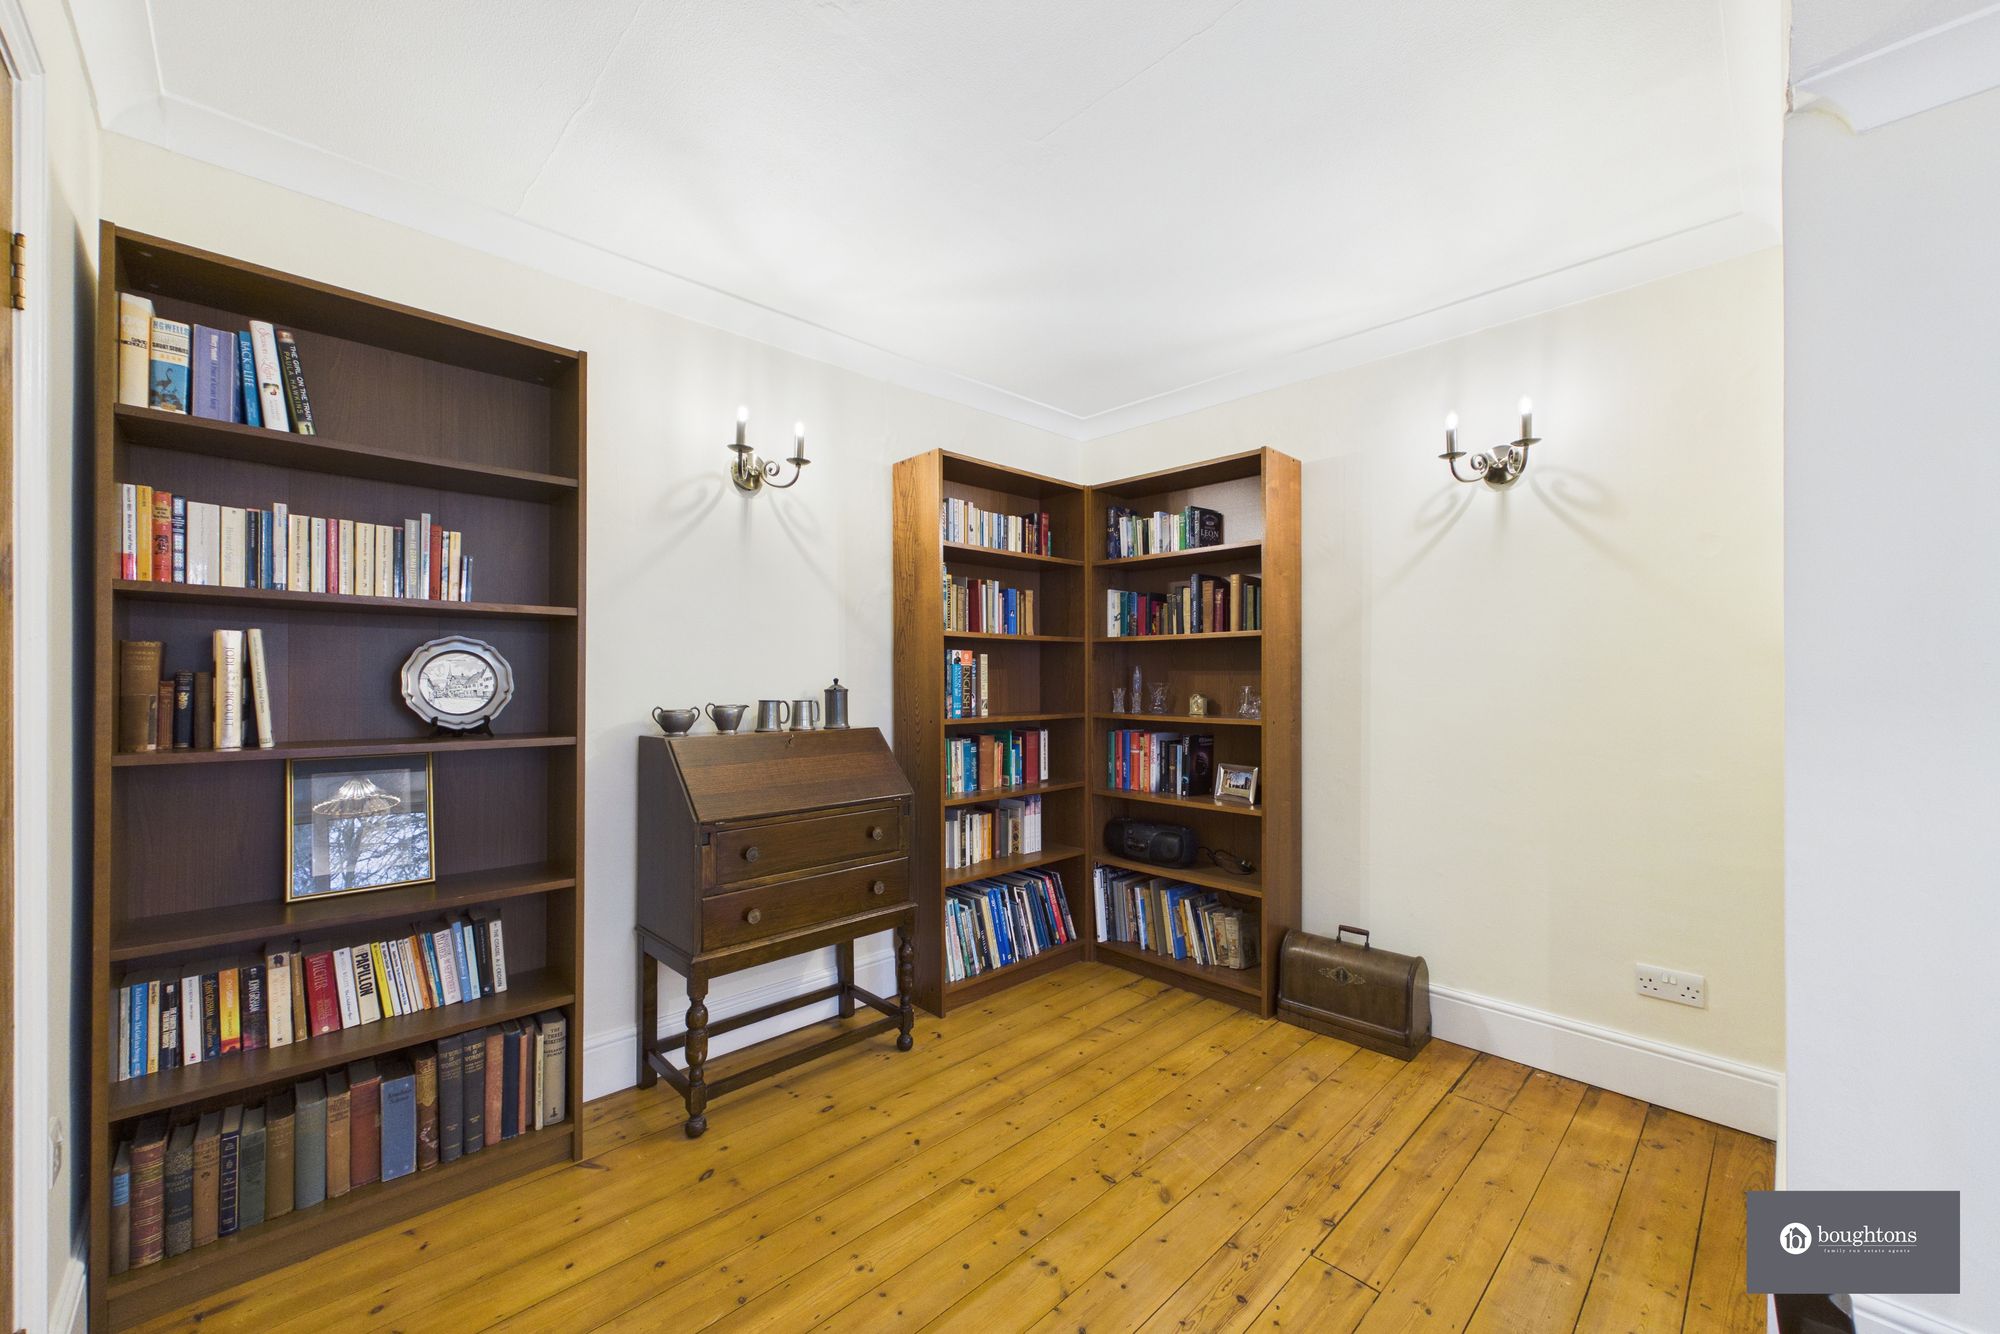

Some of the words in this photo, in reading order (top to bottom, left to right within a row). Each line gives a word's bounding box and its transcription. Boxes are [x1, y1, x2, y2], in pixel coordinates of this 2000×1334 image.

[240, 340, 252, 364] BACK
[289, 346, 297, 358] THE
[292, 360, 301, 375] GIRL
[243, 370, 254, 388] LIFE
[283, 351, 294, 376] PAULA
[290, 379, 303, 414] HAWKINS
[297, 376, 304, 386] ON
[303, 402, 312, 421] TRAIN
[224, 647, 235, 666] JODI
[224, 691, 234, 727] PICOULT
[355, 952, 374, 997] PAPILLON
